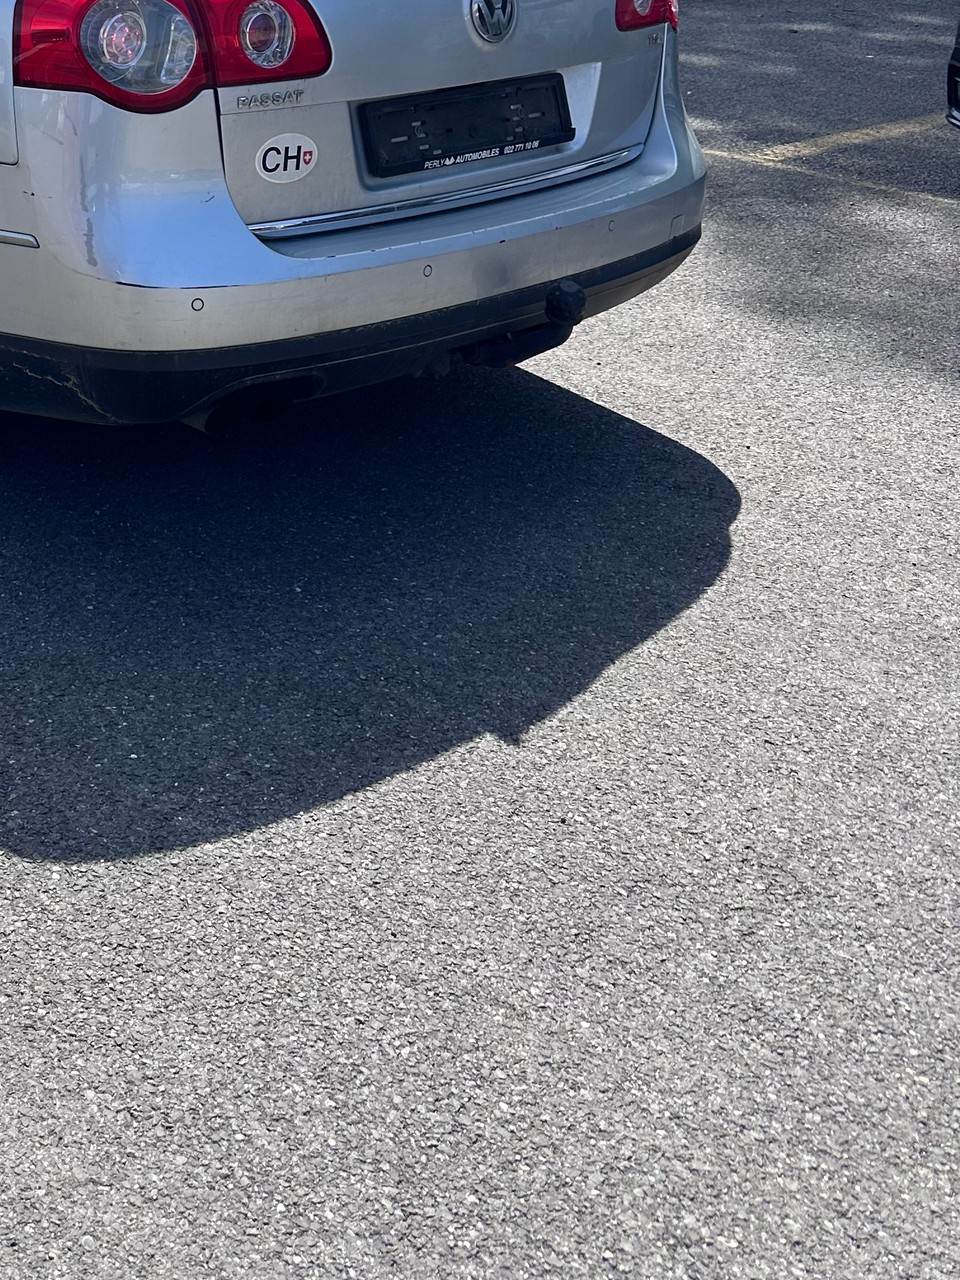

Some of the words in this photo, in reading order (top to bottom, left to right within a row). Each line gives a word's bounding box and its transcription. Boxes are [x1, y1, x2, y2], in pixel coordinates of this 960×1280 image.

[237, 89, 304, 109] PASSAT
[262, 145, 302, 173] CH
[424, 158, 445, 169] PERLY
[455, 148, 500, 163] AUTOMOBILES
[504, 145, 514, 154] 022
